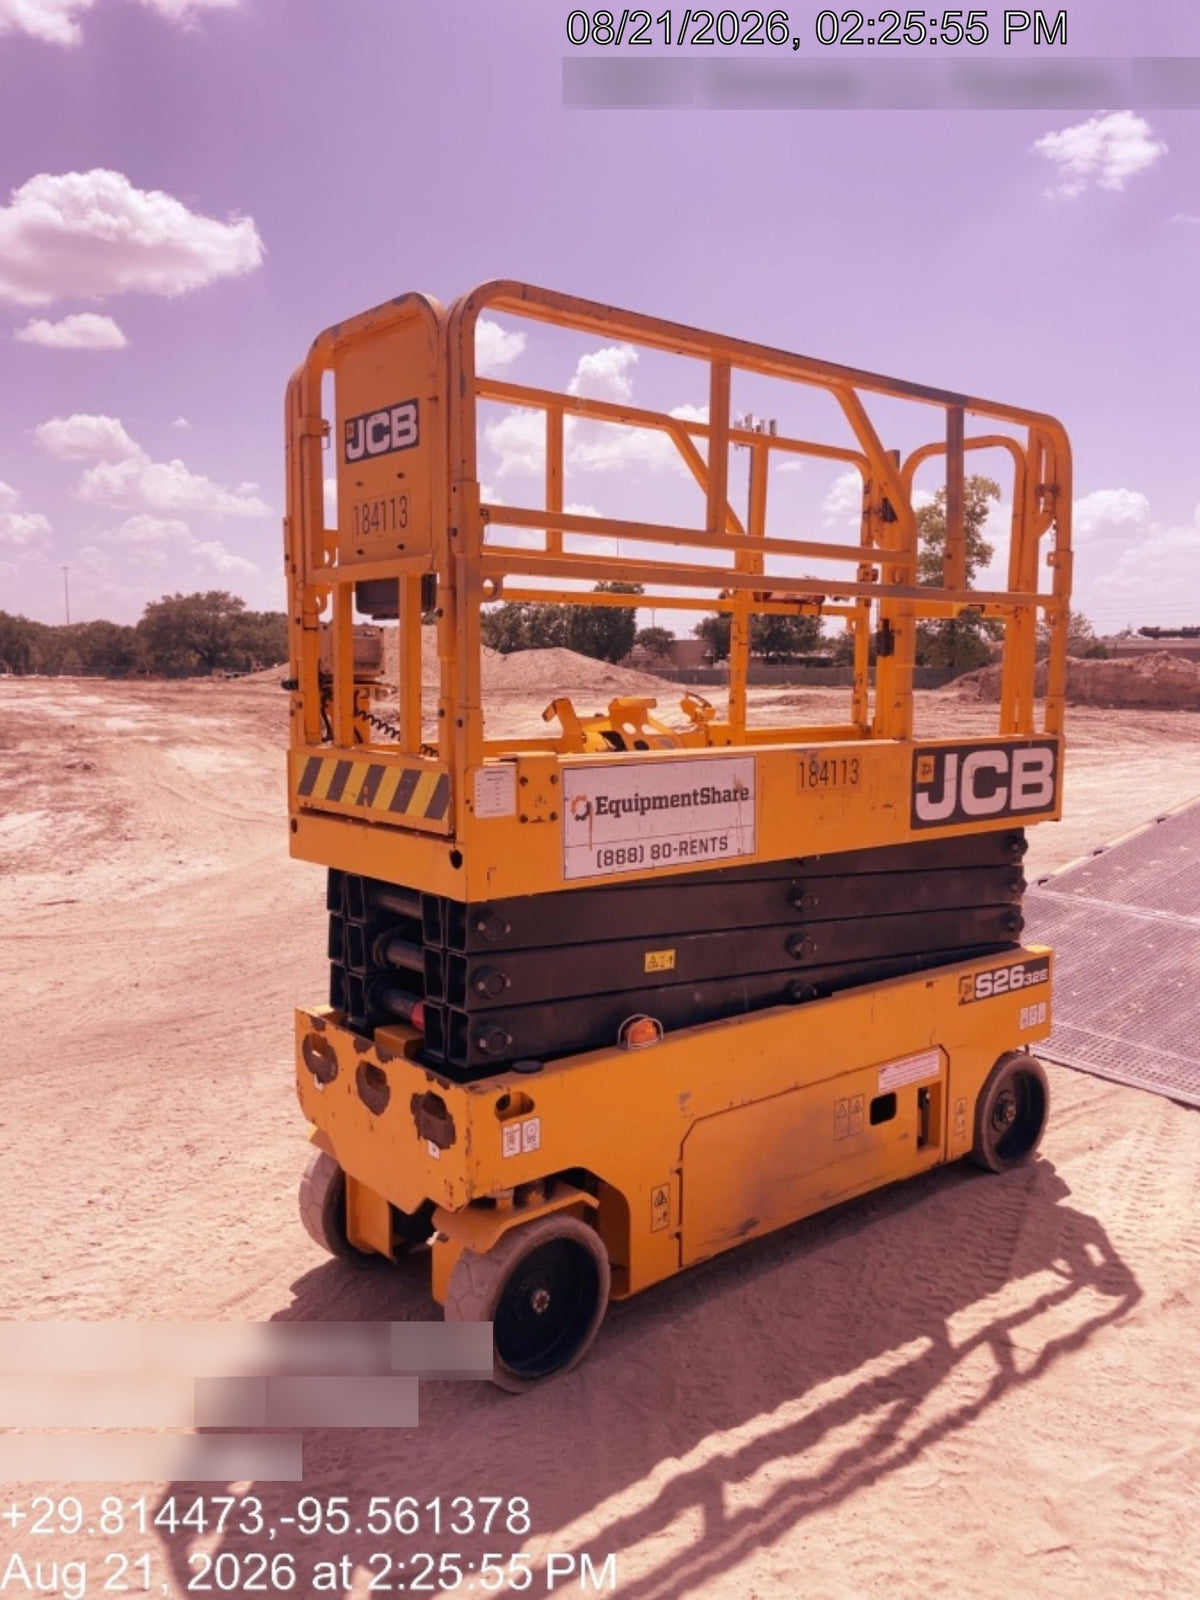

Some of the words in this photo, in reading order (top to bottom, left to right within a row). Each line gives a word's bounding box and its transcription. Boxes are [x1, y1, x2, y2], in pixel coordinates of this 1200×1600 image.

[346, 403, 418, 461] JCB
[353, 494, 408, 536] 184113
[799, 758, 860, 789] 184113
[915, 747, 1054, 821] JCB
[594, 786, 750, 819] EquipmentShare
[596, 846, 645, 869] (888)
[650, 836, 729, 861] 80-RENTS
